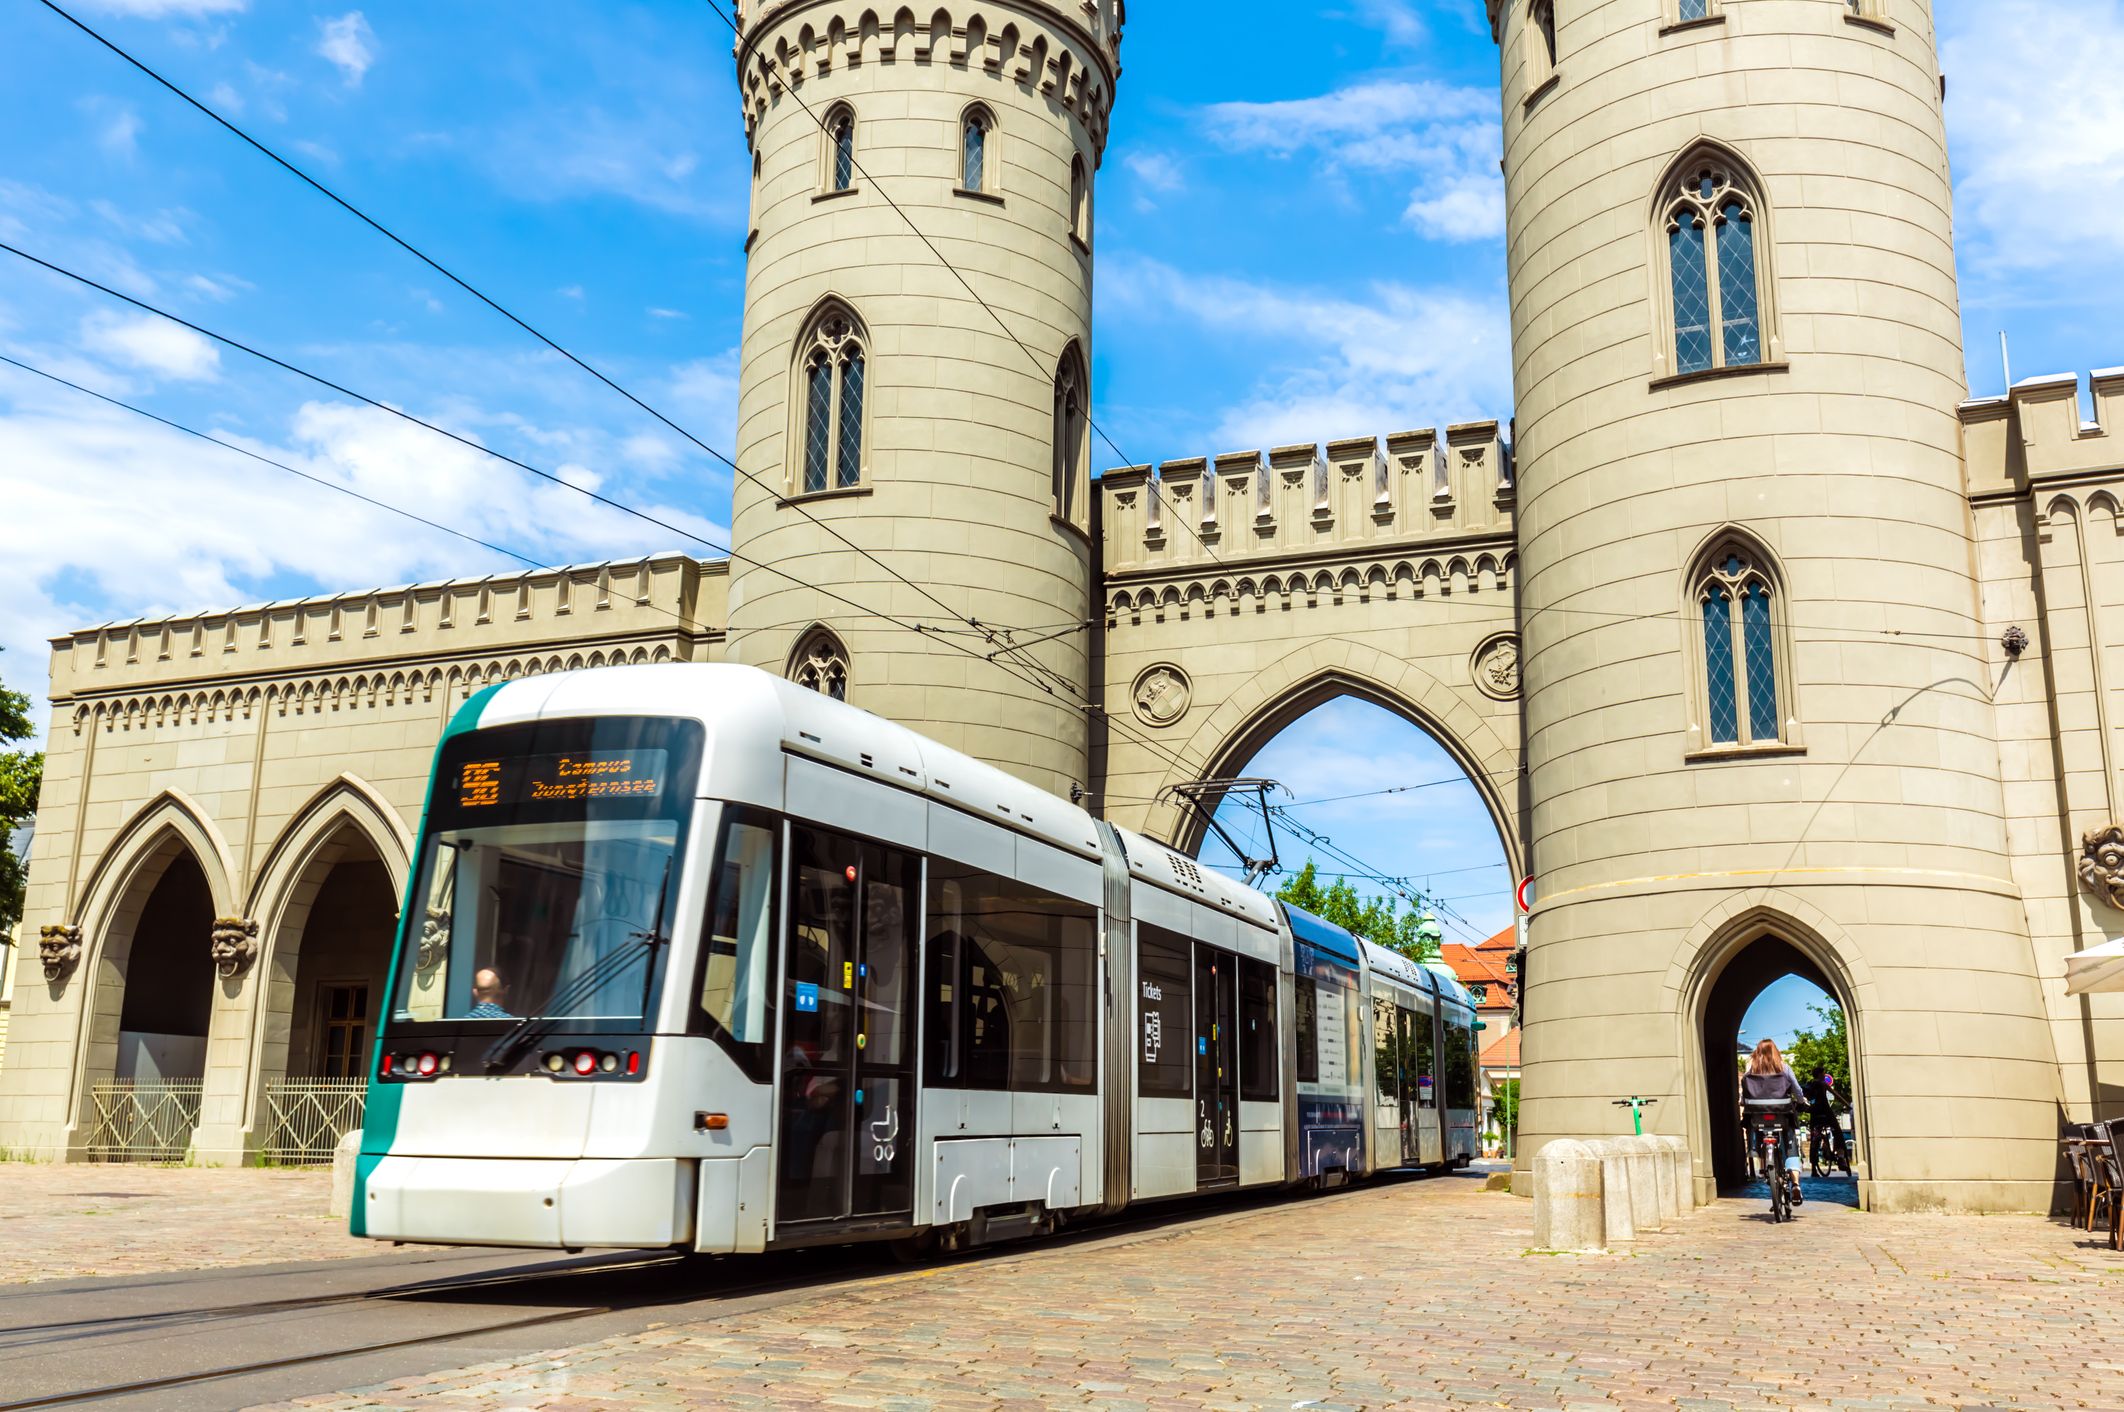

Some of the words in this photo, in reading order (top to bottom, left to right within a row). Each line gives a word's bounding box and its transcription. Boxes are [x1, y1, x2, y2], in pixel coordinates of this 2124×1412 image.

[558, 758, 631, 777] Campus
[1142, 981, 1161, 1000] Tickets
[1200, 1099, 1205, 1117] 2
